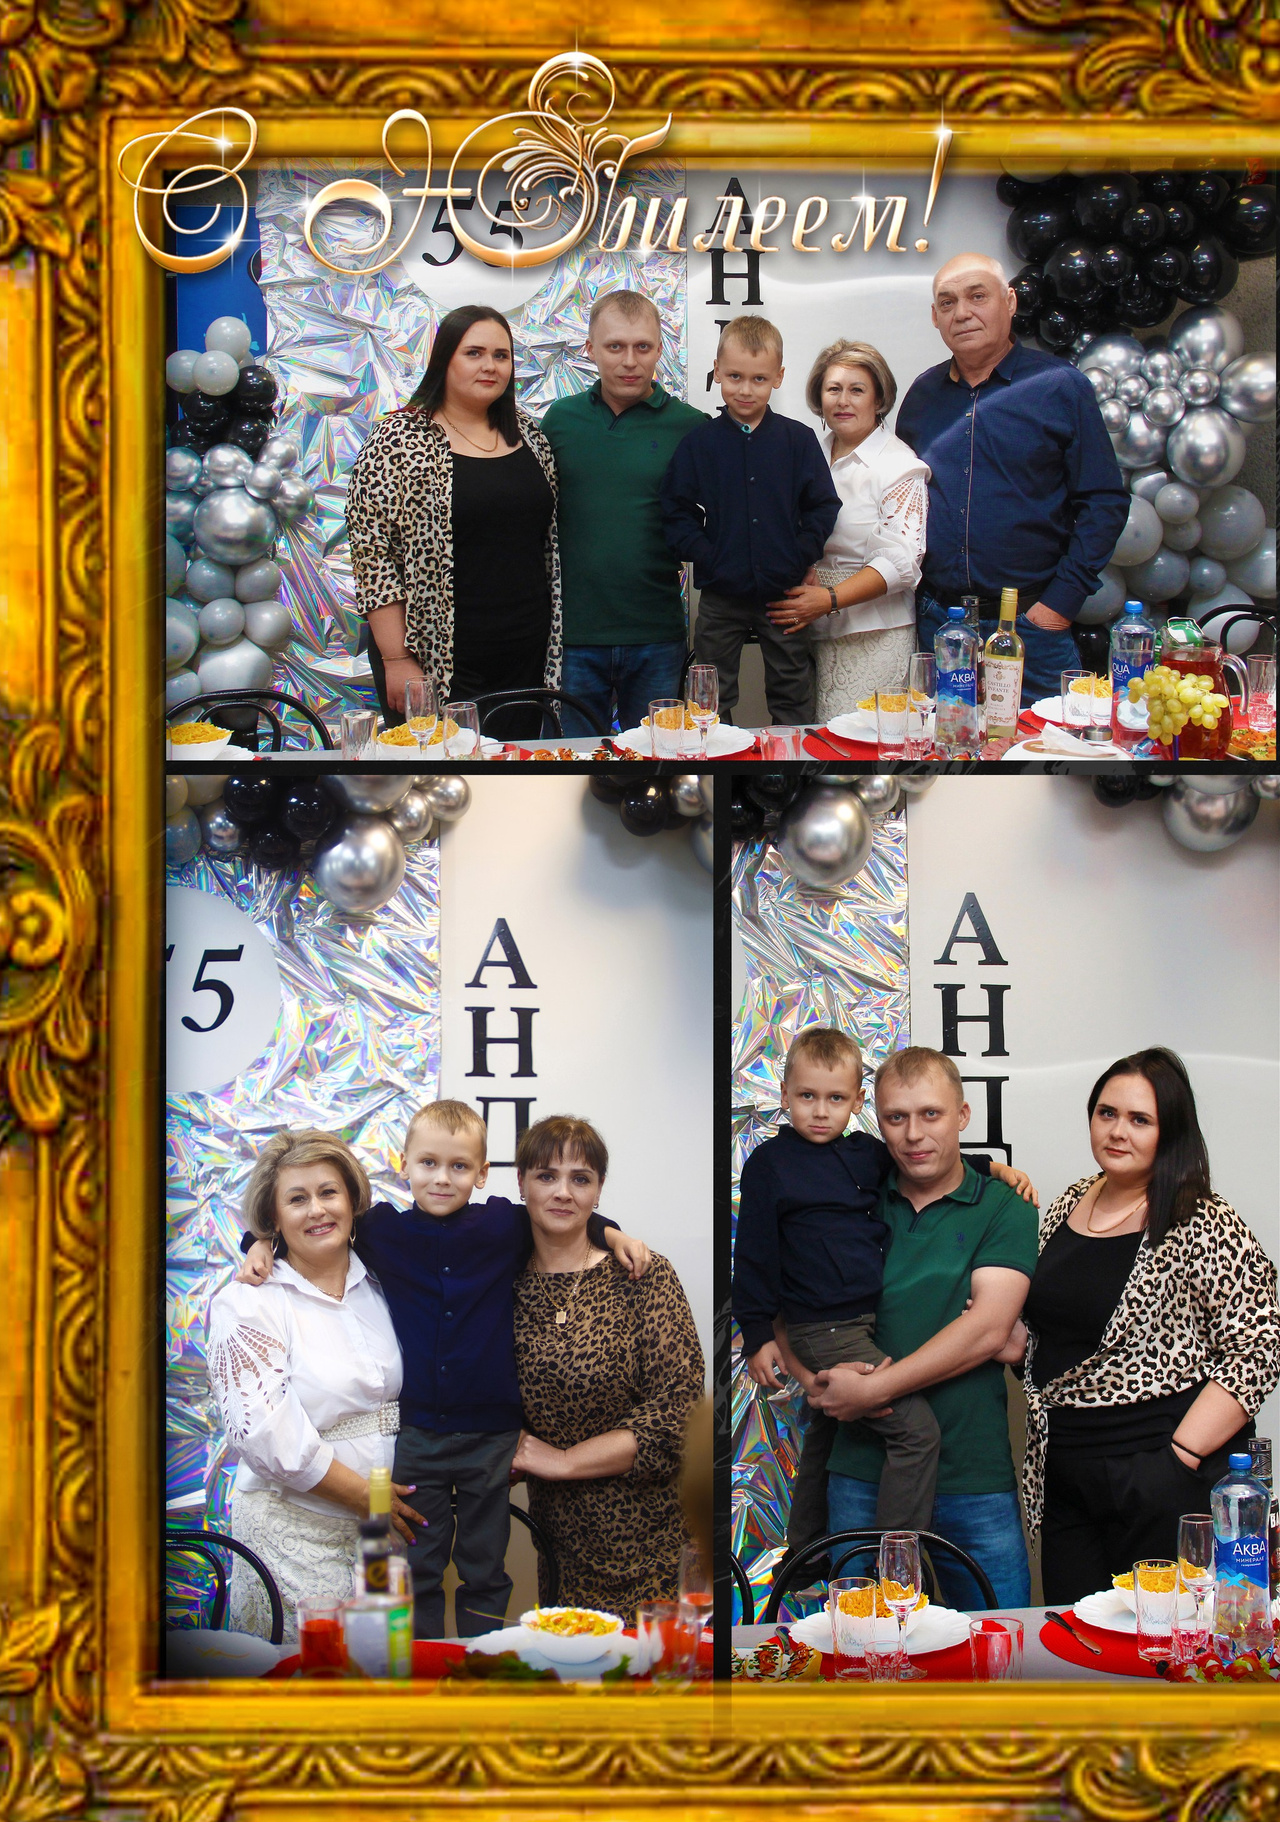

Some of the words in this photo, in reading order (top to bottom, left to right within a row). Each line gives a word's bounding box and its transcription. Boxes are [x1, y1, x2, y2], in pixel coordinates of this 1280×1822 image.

[950, 671, 976, 684] АКВА
[166, 944, 245, 1033] 5
[1232, 1541, 1266, 1556] АКВА
